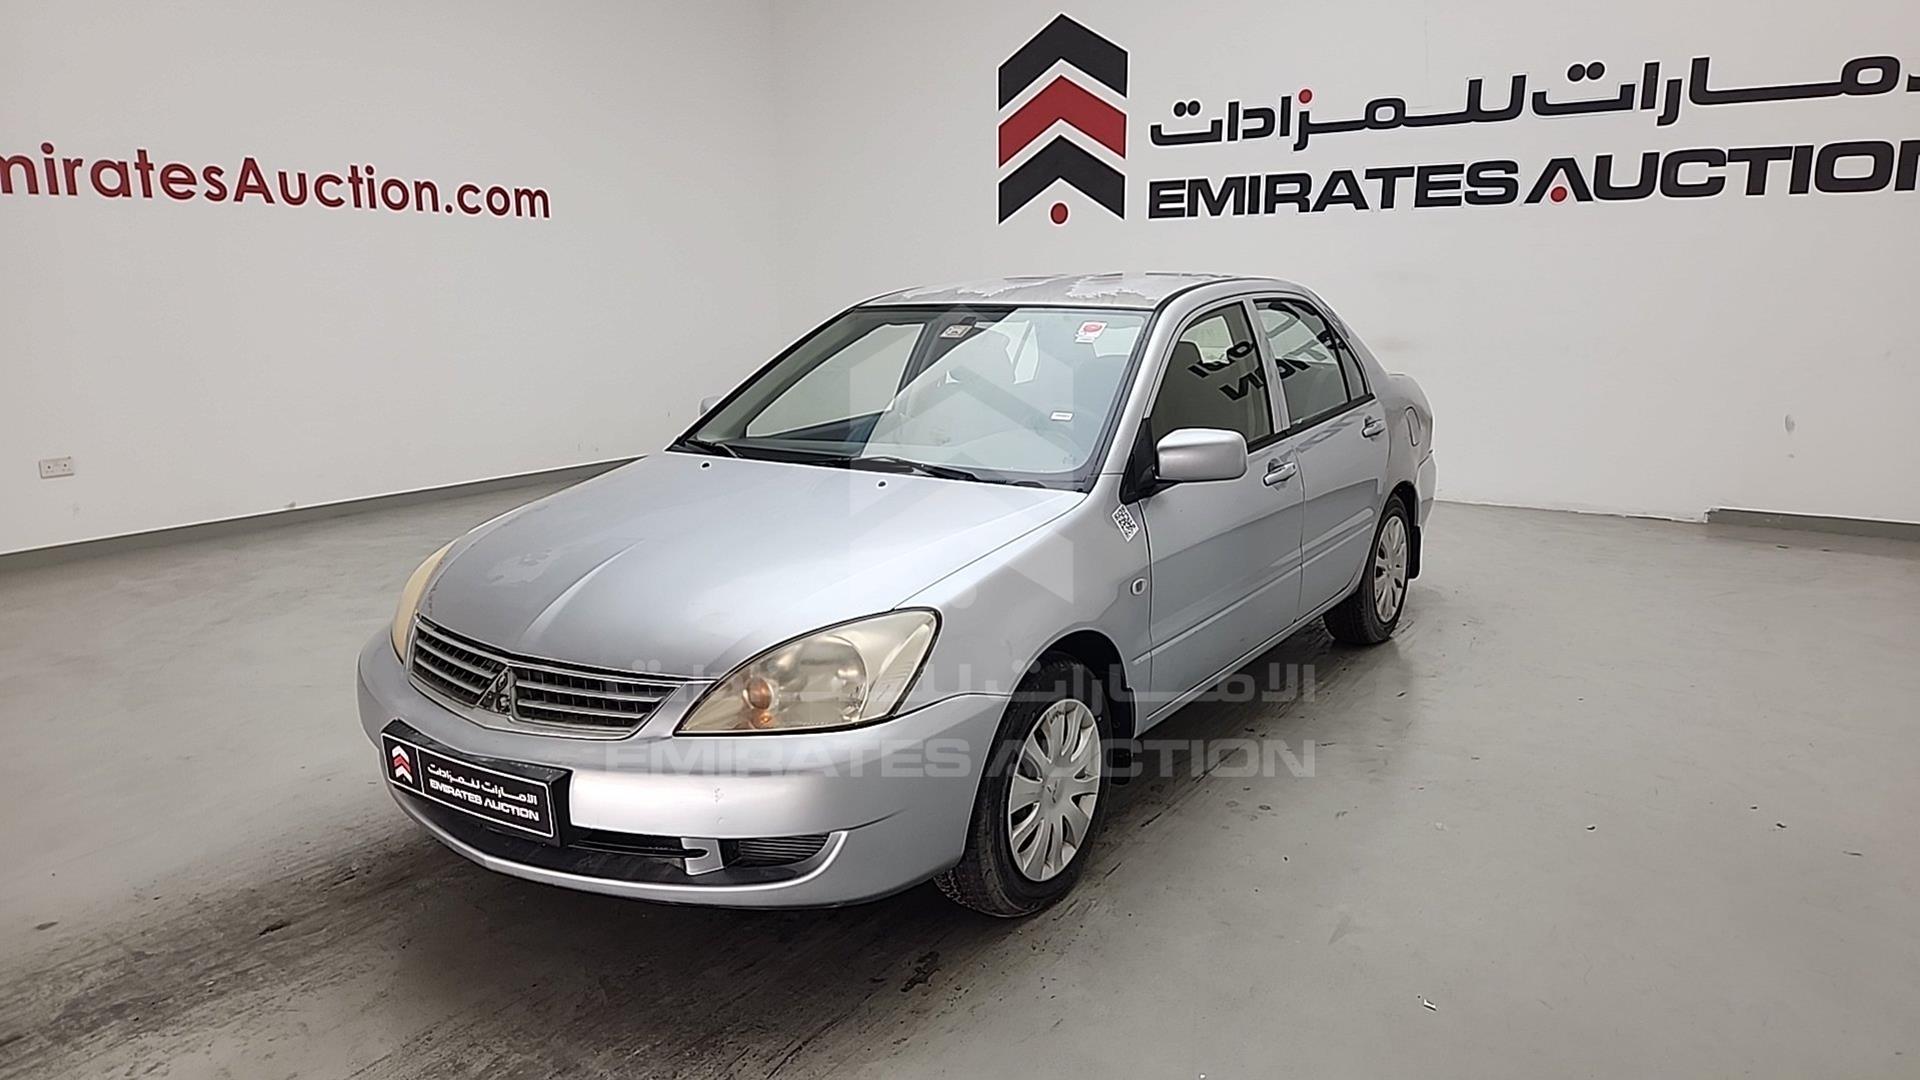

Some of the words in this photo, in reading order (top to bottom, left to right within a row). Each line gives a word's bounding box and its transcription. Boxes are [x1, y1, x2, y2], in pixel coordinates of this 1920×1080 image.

[1150, 74, 1527, 152] للمزادات
[1532, 55, 1920, 126] مارات
[1148, 159, 1519, 220] EMIRATES
[429, 778, 483, 807] EMIRATES
[484, 797, 540, 822] AUCTION
